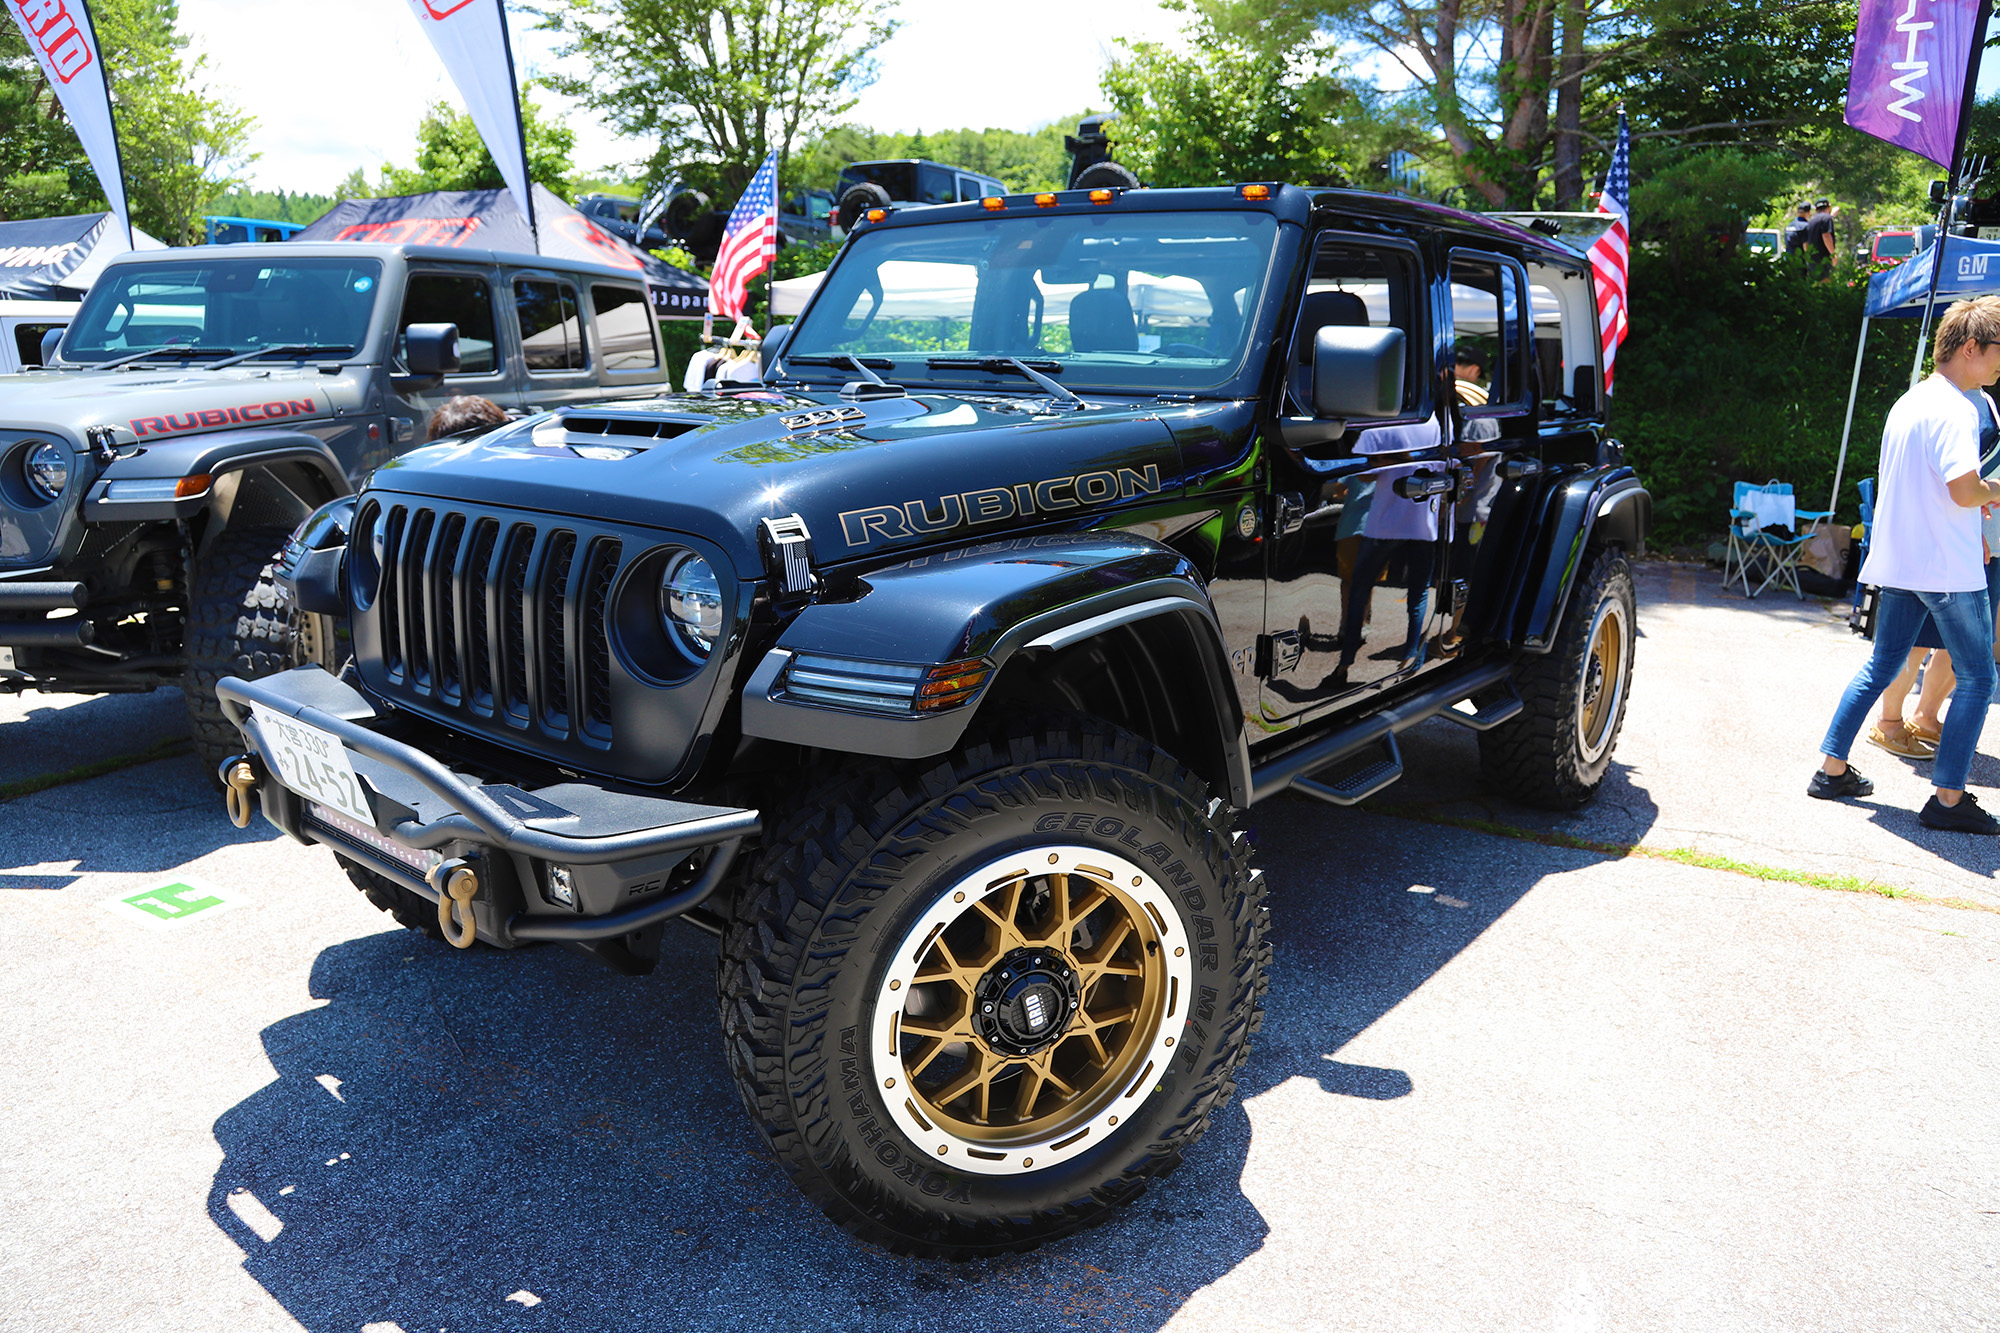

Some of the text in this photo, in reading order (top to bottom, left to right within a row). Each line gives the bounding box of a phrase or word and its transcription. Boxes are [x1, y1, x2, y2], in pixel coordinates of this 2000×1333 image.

[13, 0, 93, 84] RID
[1957, 255, 1989, 275] GM
[129, 398, 317, 436] RUBICON
[779, 407, 867, 431] 392
[838, 463, 1161, 547] RUBICON
[284, 746, 368, 818] 24-52
[629, 880, 660, 896] RC
[1033, 812, 1219, 973] GEOLANDAR
[1181, 985, 1219, 1075] M/T
[1025, 994, 1044, 1027] GRID
[839, 1025, 973, 1205] YOKOHAMA
